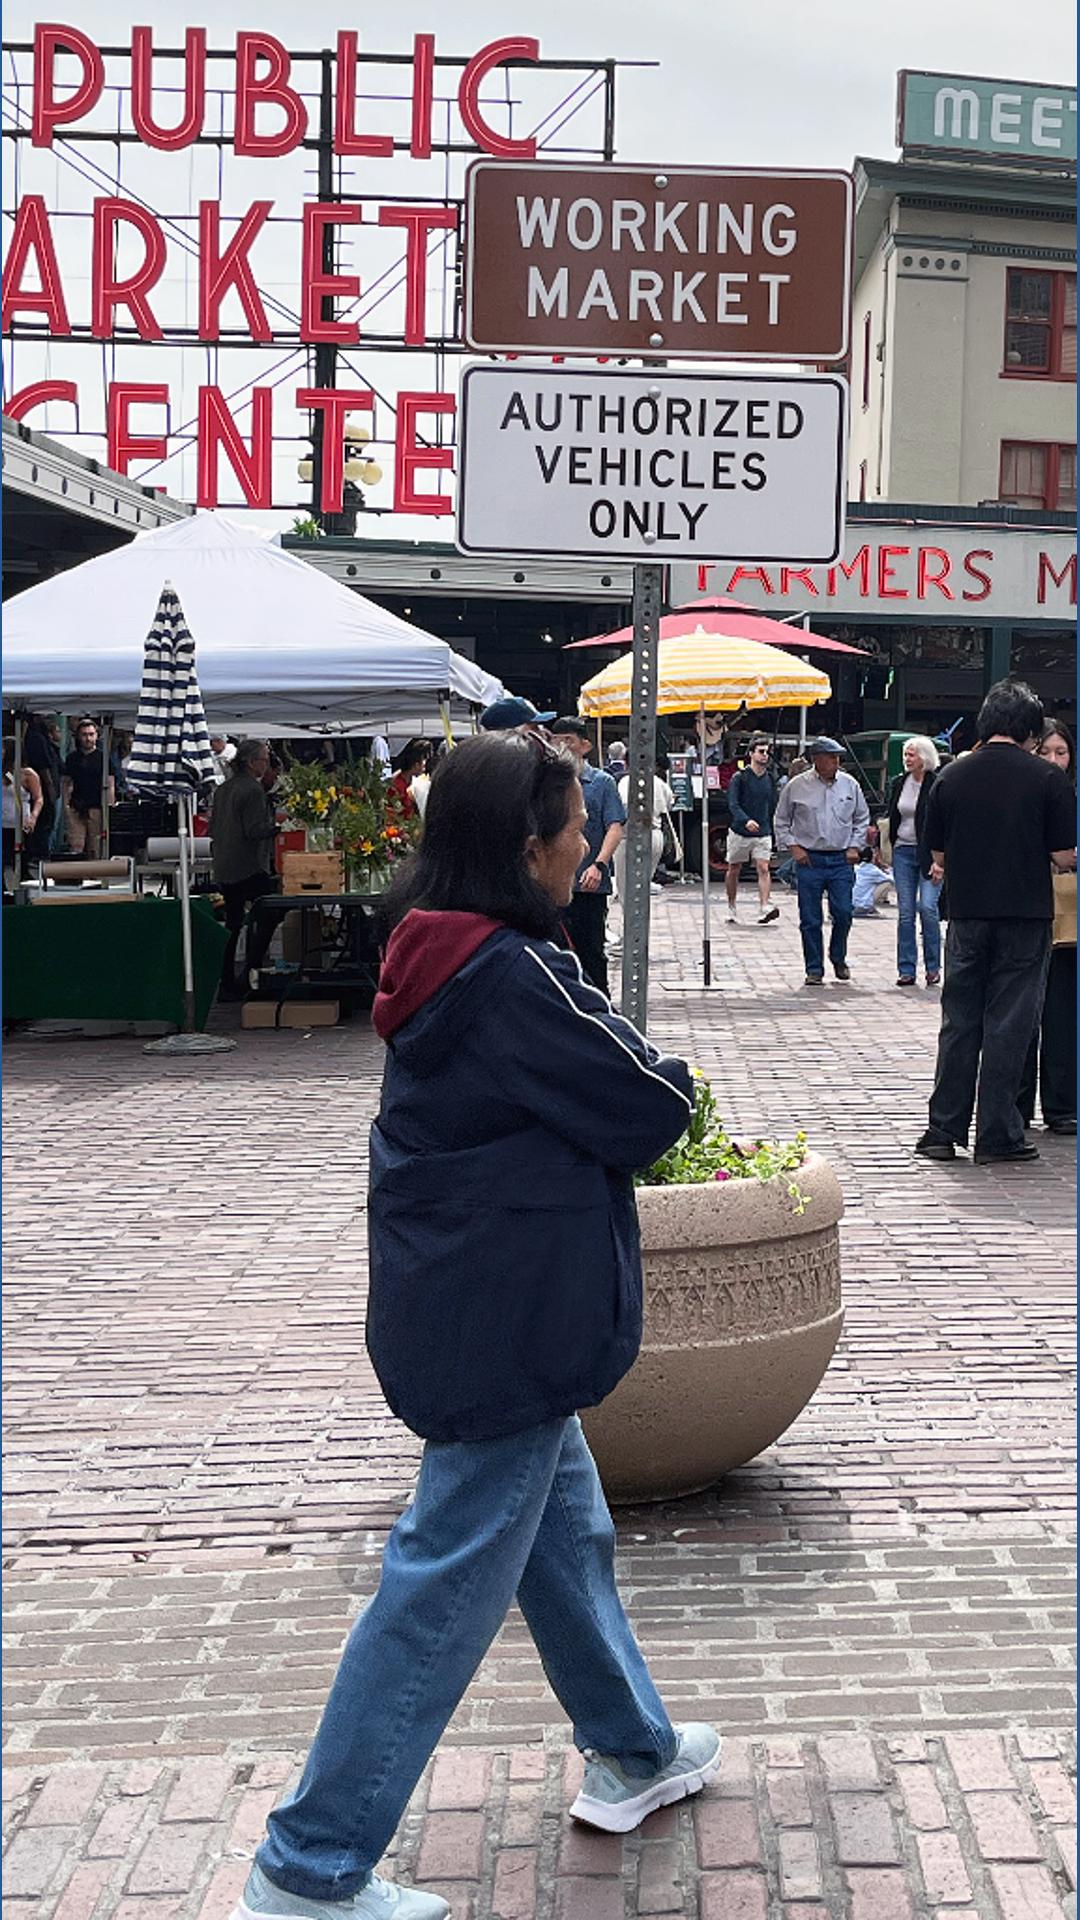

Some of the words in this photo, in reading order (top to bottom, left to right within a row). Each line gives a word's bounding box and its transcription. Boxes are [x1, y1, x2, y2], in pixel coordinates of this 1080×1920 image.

[31, 22, 540, 159] PUBLIC
[515, 196, 798, 257] WORKING
[526, 265, 792, 326] MARKET
[499, 391, 805, 440] AUTHORIZED
[535, 445, 768, 492] VEHICLES
[588, 499, 709, 542] ONLY
